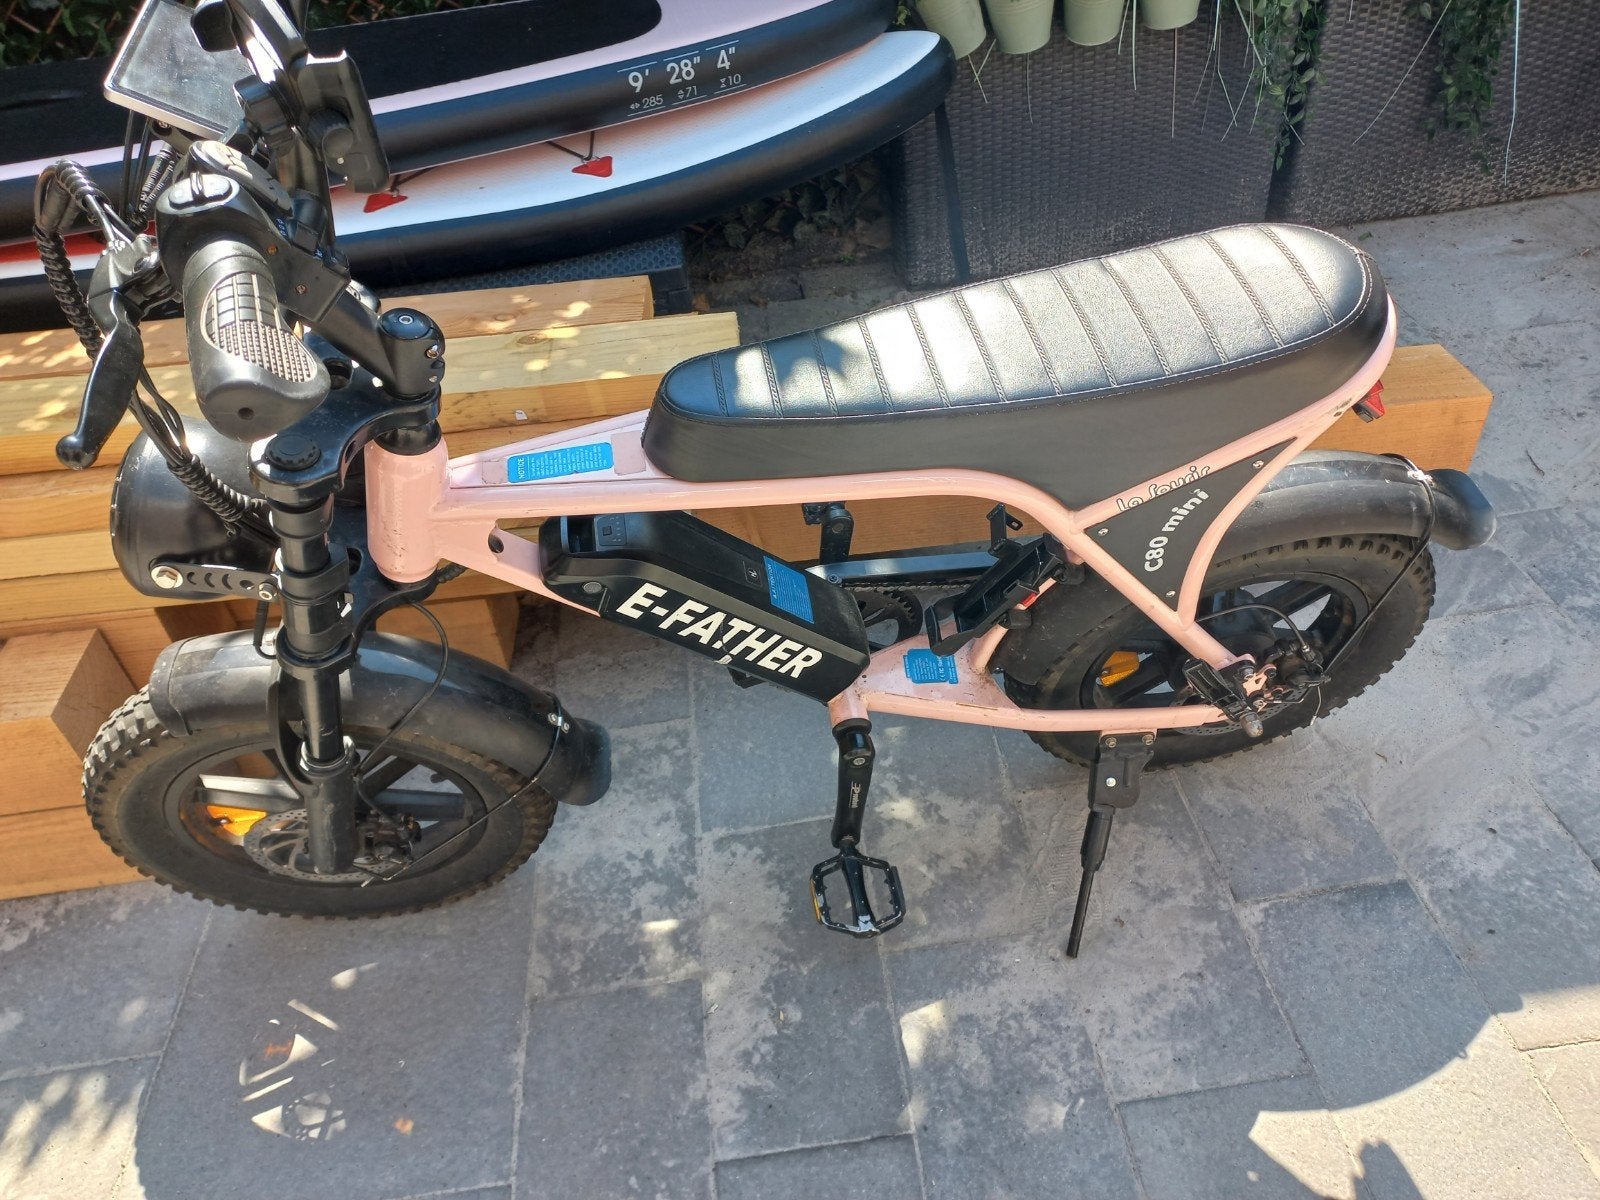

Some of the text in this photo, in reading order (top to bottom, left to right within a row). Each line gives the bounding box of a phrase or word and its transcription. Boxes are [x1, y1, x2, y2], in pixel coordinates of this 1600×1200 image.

[628, 46, 736, 93] 9' 28" 4"
[642, 73, 742, 110] 285 71 10
[517, 457, 526, 480] NOTICE
[1144, 488, 1210, 572] C80 mini
[615, 582, 824, 679] E-FATHER
